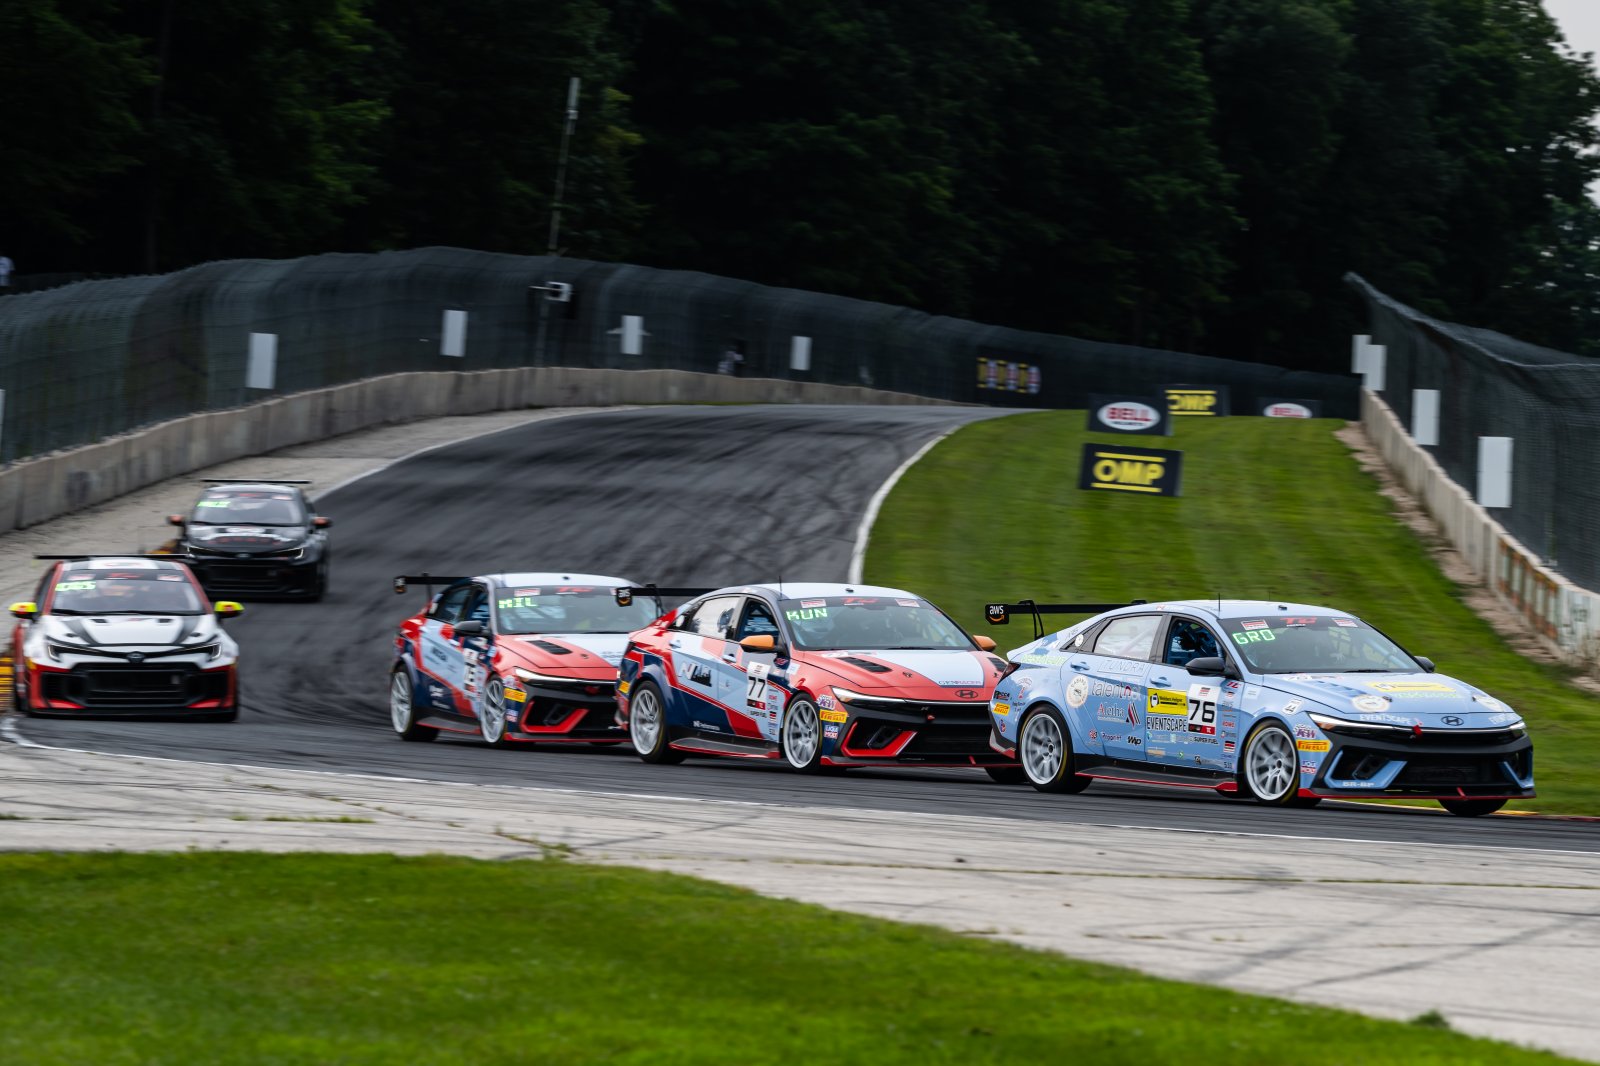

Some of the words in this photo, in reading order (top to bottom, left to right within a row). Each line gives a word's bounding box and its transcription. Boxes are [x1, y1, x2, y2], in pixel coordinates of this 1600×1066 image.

[1106, 407, 1152, 421] BELL
[1093, 459, 1165, 485] OMP
[989, 605, 1004, 615] aws
[747, 676, 765, 698] 77
[1188, 698, 1216, 724] 76
[1146, 716, 1188, 733] EVENTSCAPE
[1297, 740, 1328, 750] PIRELLI
